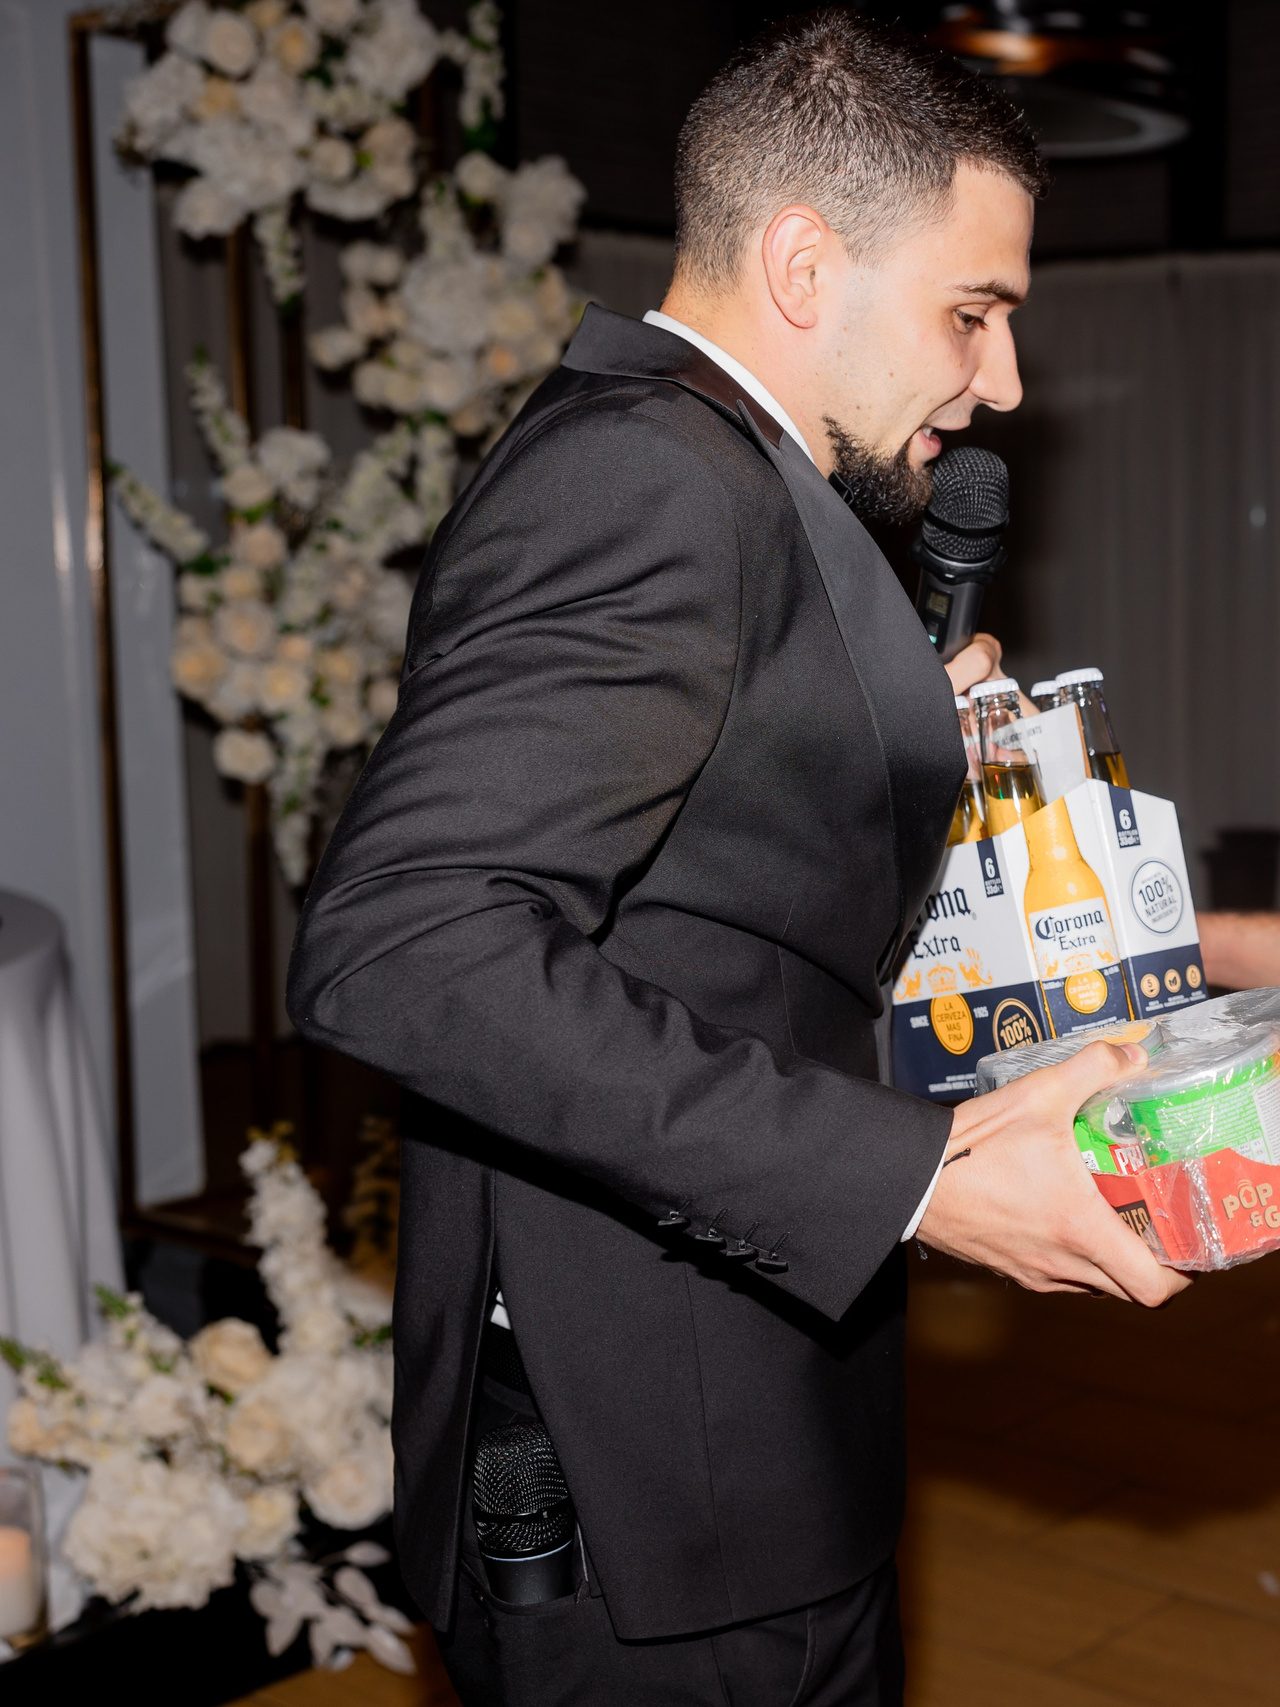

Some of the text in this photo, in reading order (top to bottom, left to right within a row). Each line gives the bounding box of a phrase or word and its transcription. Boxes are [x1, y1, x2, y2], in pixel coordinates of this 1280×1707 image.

[1118, 808, 1132, 830] 6
[984, 857, 996, 879] 6
[1138, 874, 1174, 906] 100%
[1145, 898, 1178, 918] NATURAL
[1035, 910, 1105, 941] Corona
[909, 931, 962, 960] Extra
[1058, 934, 1097, 951] Extra
[935, 1010, 967, 1023] CERVEZA
[943, 1002, 954, 1012] LA
[946, 1022, 962, 1032] MAS
[948, 1033, 965, 1043] FINA
[1000, 1016, 1033, 1048] 100%
[1222, 1182, 1274, 1220] POP
